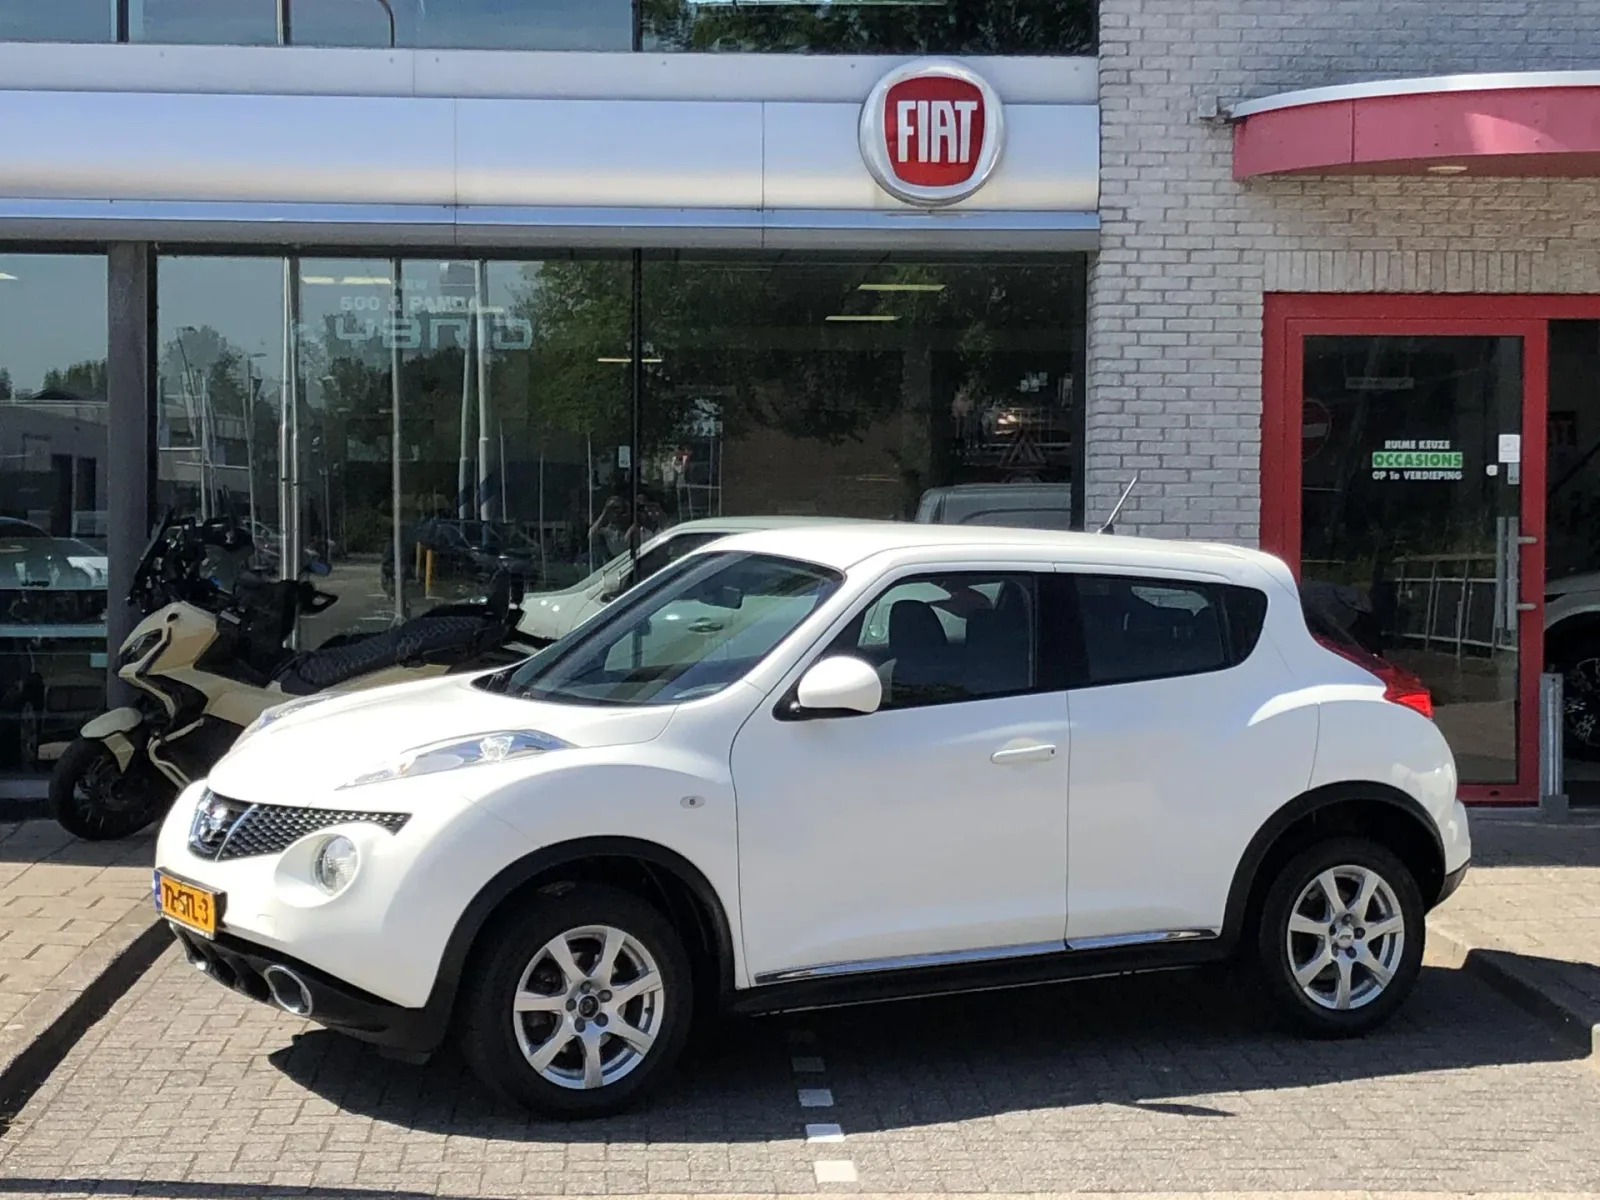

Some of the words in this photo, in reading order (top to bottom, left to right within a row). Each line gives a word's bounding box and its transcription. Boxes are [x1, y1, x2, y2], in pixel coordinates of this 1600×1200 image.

[897, 100, 978, 163] FIAT
[340, 296, 380, 311] 500
[1384, 440, 1416, 450] RUIME
[1418, 440, 1450, 450] KEUZE
[1373, 453, 1462, 467] OCCASIONS
[1372, 471, 1387, 480] OP
[1403, 471, 1462, 480] VERDIEPING
